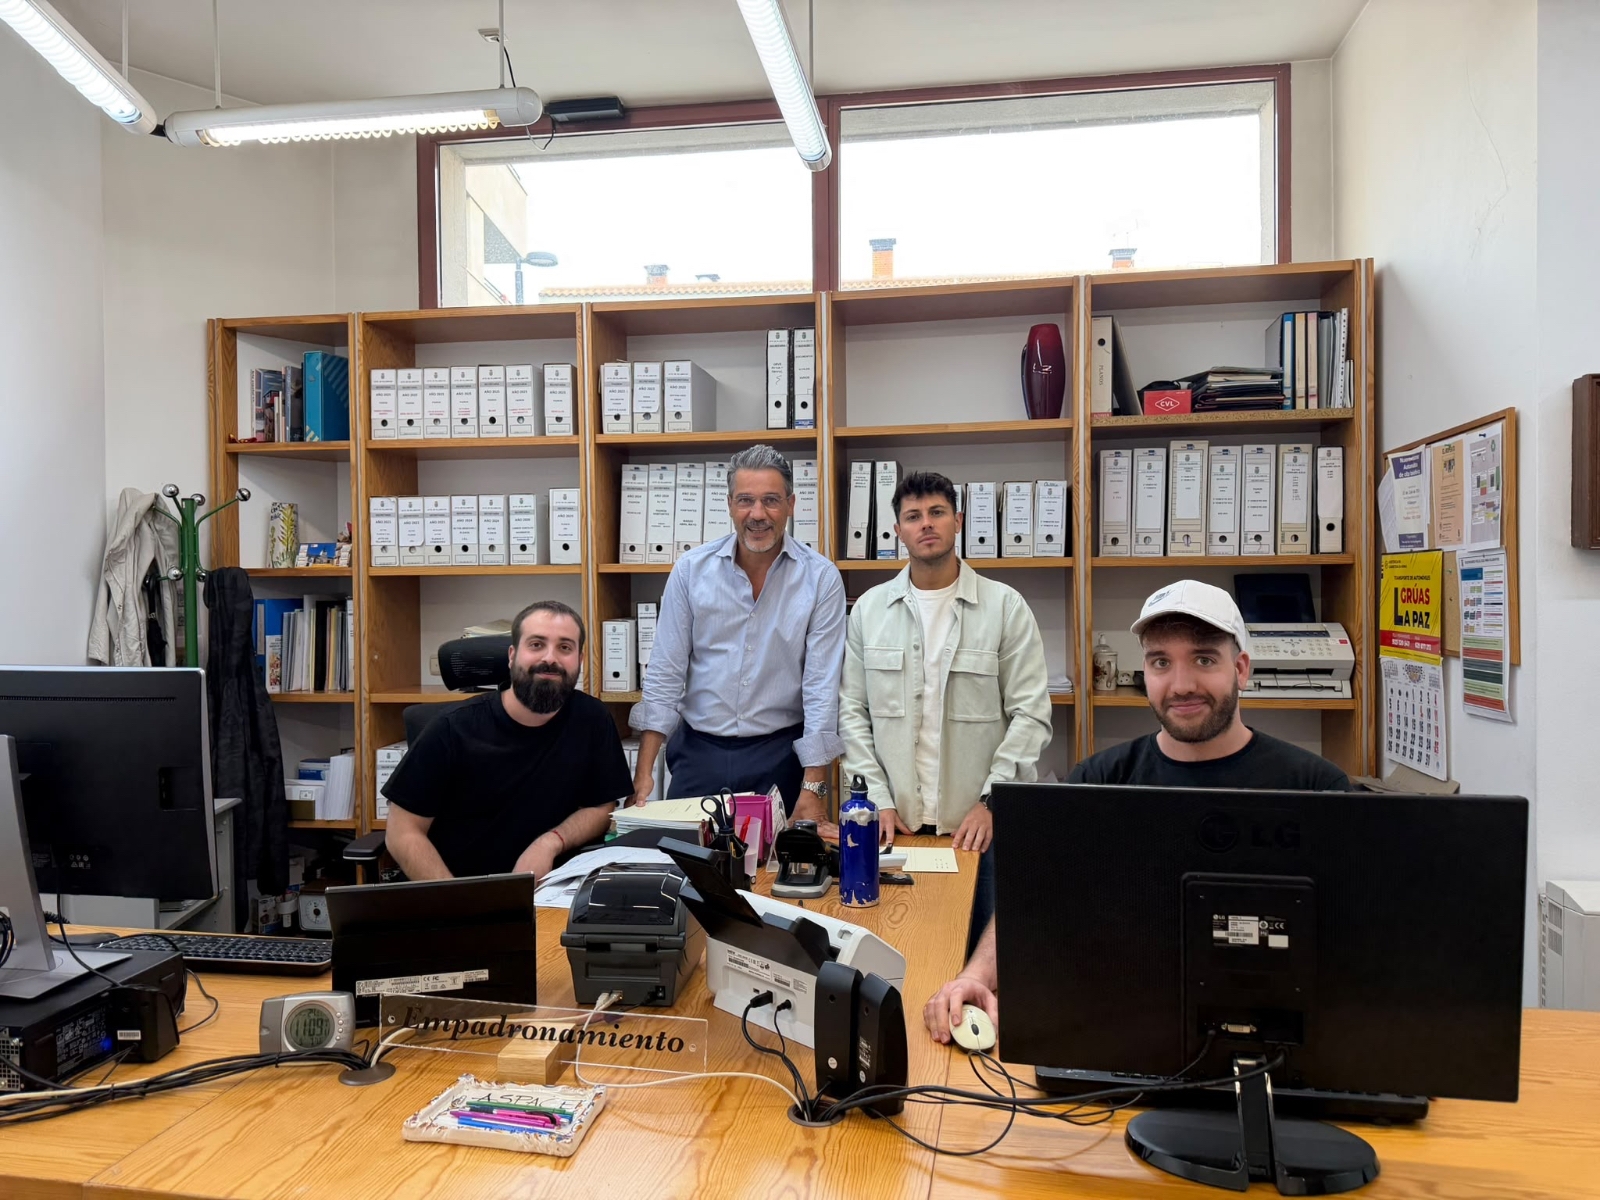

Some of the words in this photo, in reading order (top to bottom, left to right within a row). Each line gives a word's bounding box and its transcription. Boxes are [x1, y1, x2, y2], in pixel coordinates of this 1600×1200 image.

[1400, 583, 1430, 605] GRÚAS
[1412, 611, 1430, 629] PAZ
[401, 1005, 684, 1053] Empadronamiento
